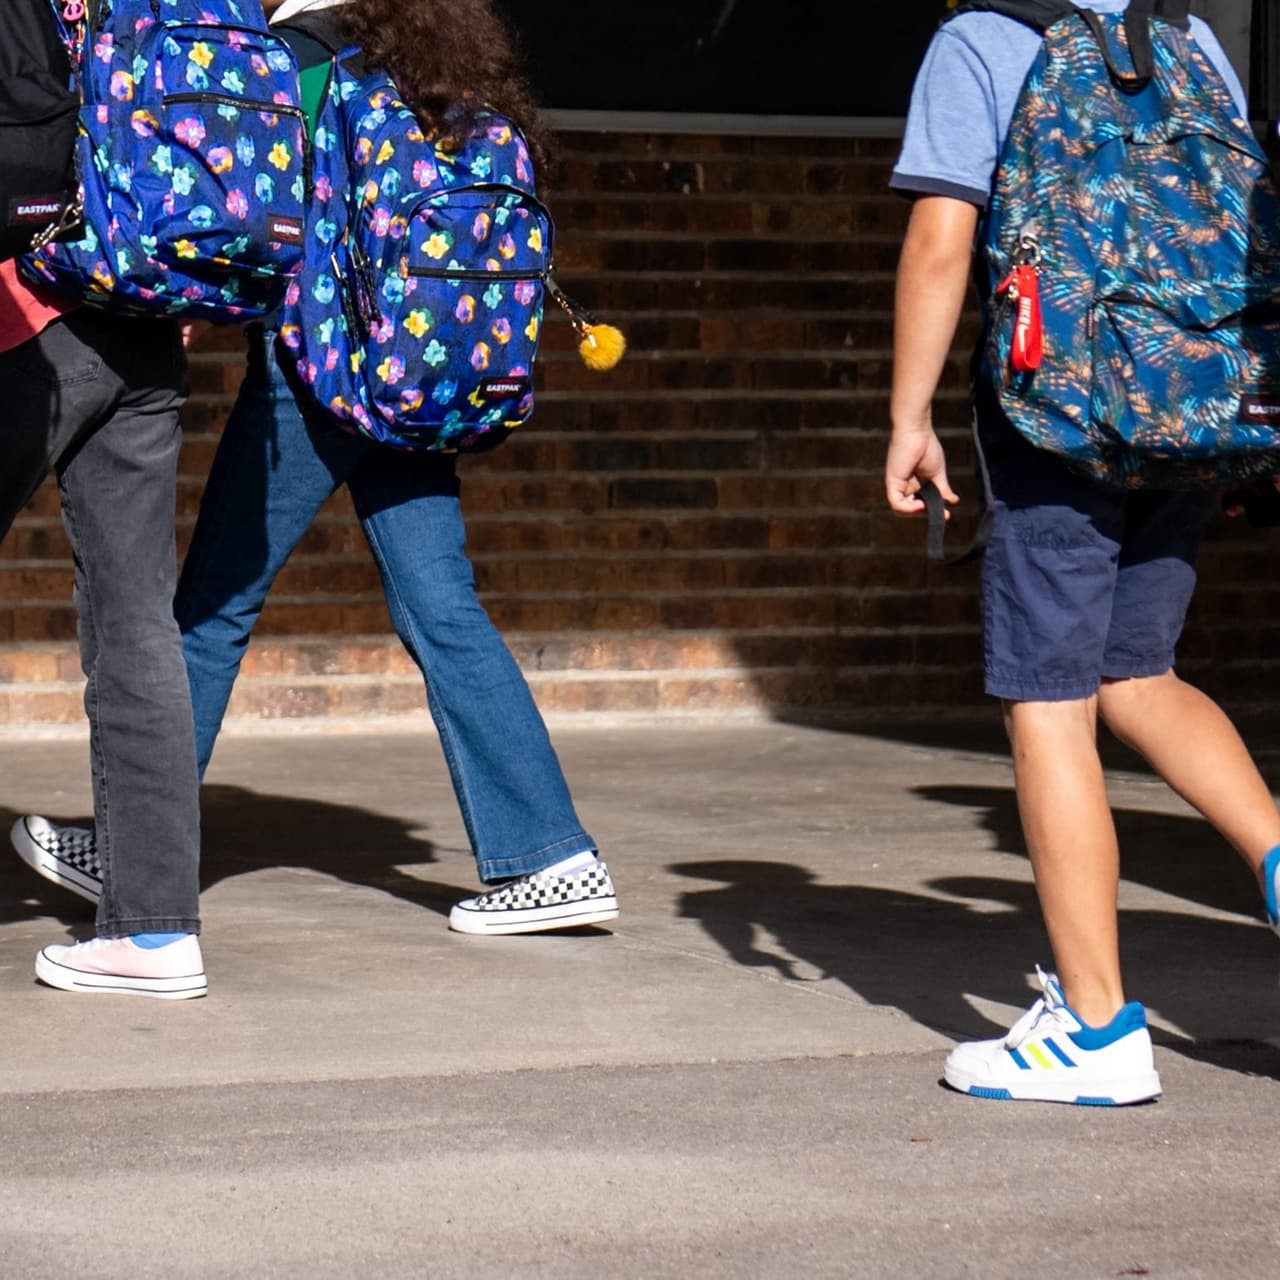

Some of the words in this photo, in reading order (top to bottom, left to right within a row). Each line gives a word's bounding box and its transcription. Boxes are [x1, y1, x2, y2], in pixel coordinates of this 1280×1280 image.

[17, 203, 60, 216] EASTPAK
[1018, 296, 1032, 325] NIKE
[486, 383, 521, 393] EASTPAK
